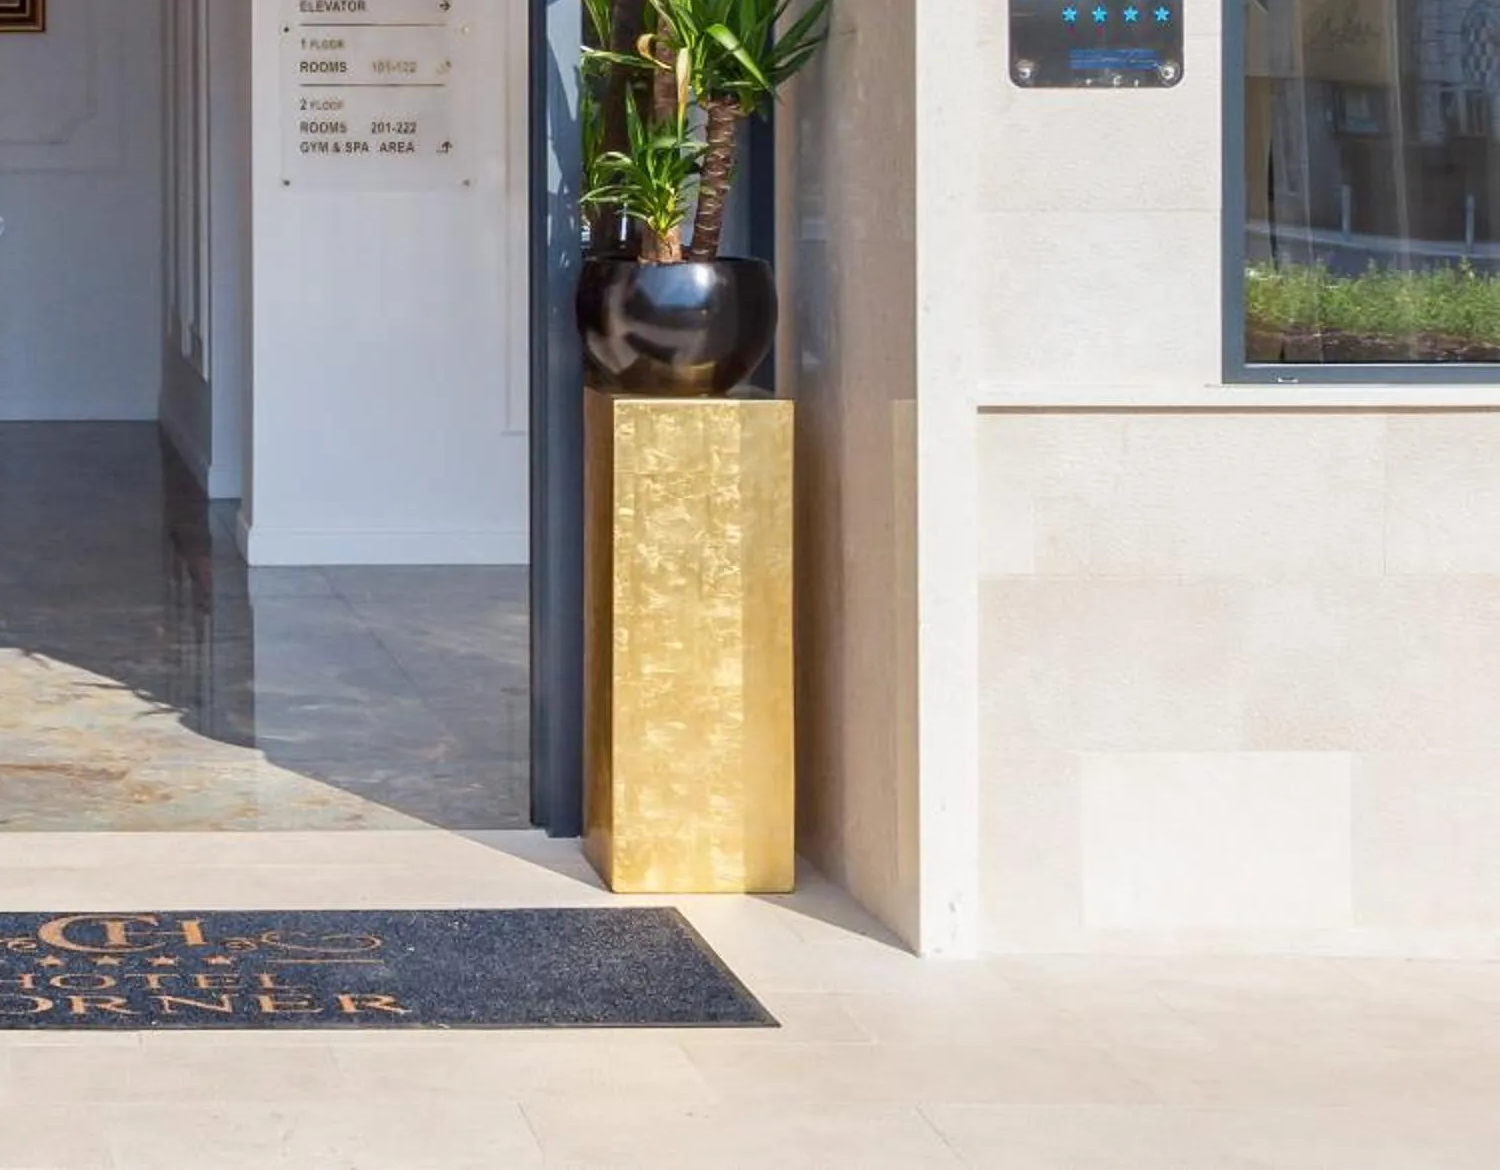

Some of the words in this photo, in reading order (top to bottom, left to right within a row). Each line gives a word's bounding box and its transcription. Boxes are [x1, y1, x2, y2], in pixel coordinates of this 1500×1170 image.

[299, 0, 367, 13] ELEVATOR
[299, 61, 348, 74] ROOMS
[299, 121, 348, 134] ROOMS
[370, 121, 418, 134] 201-222
[299, 141, 329, 154] GYM
[345, 141, 370, 154] SPA
[379, 141, 416, 154] AREA
